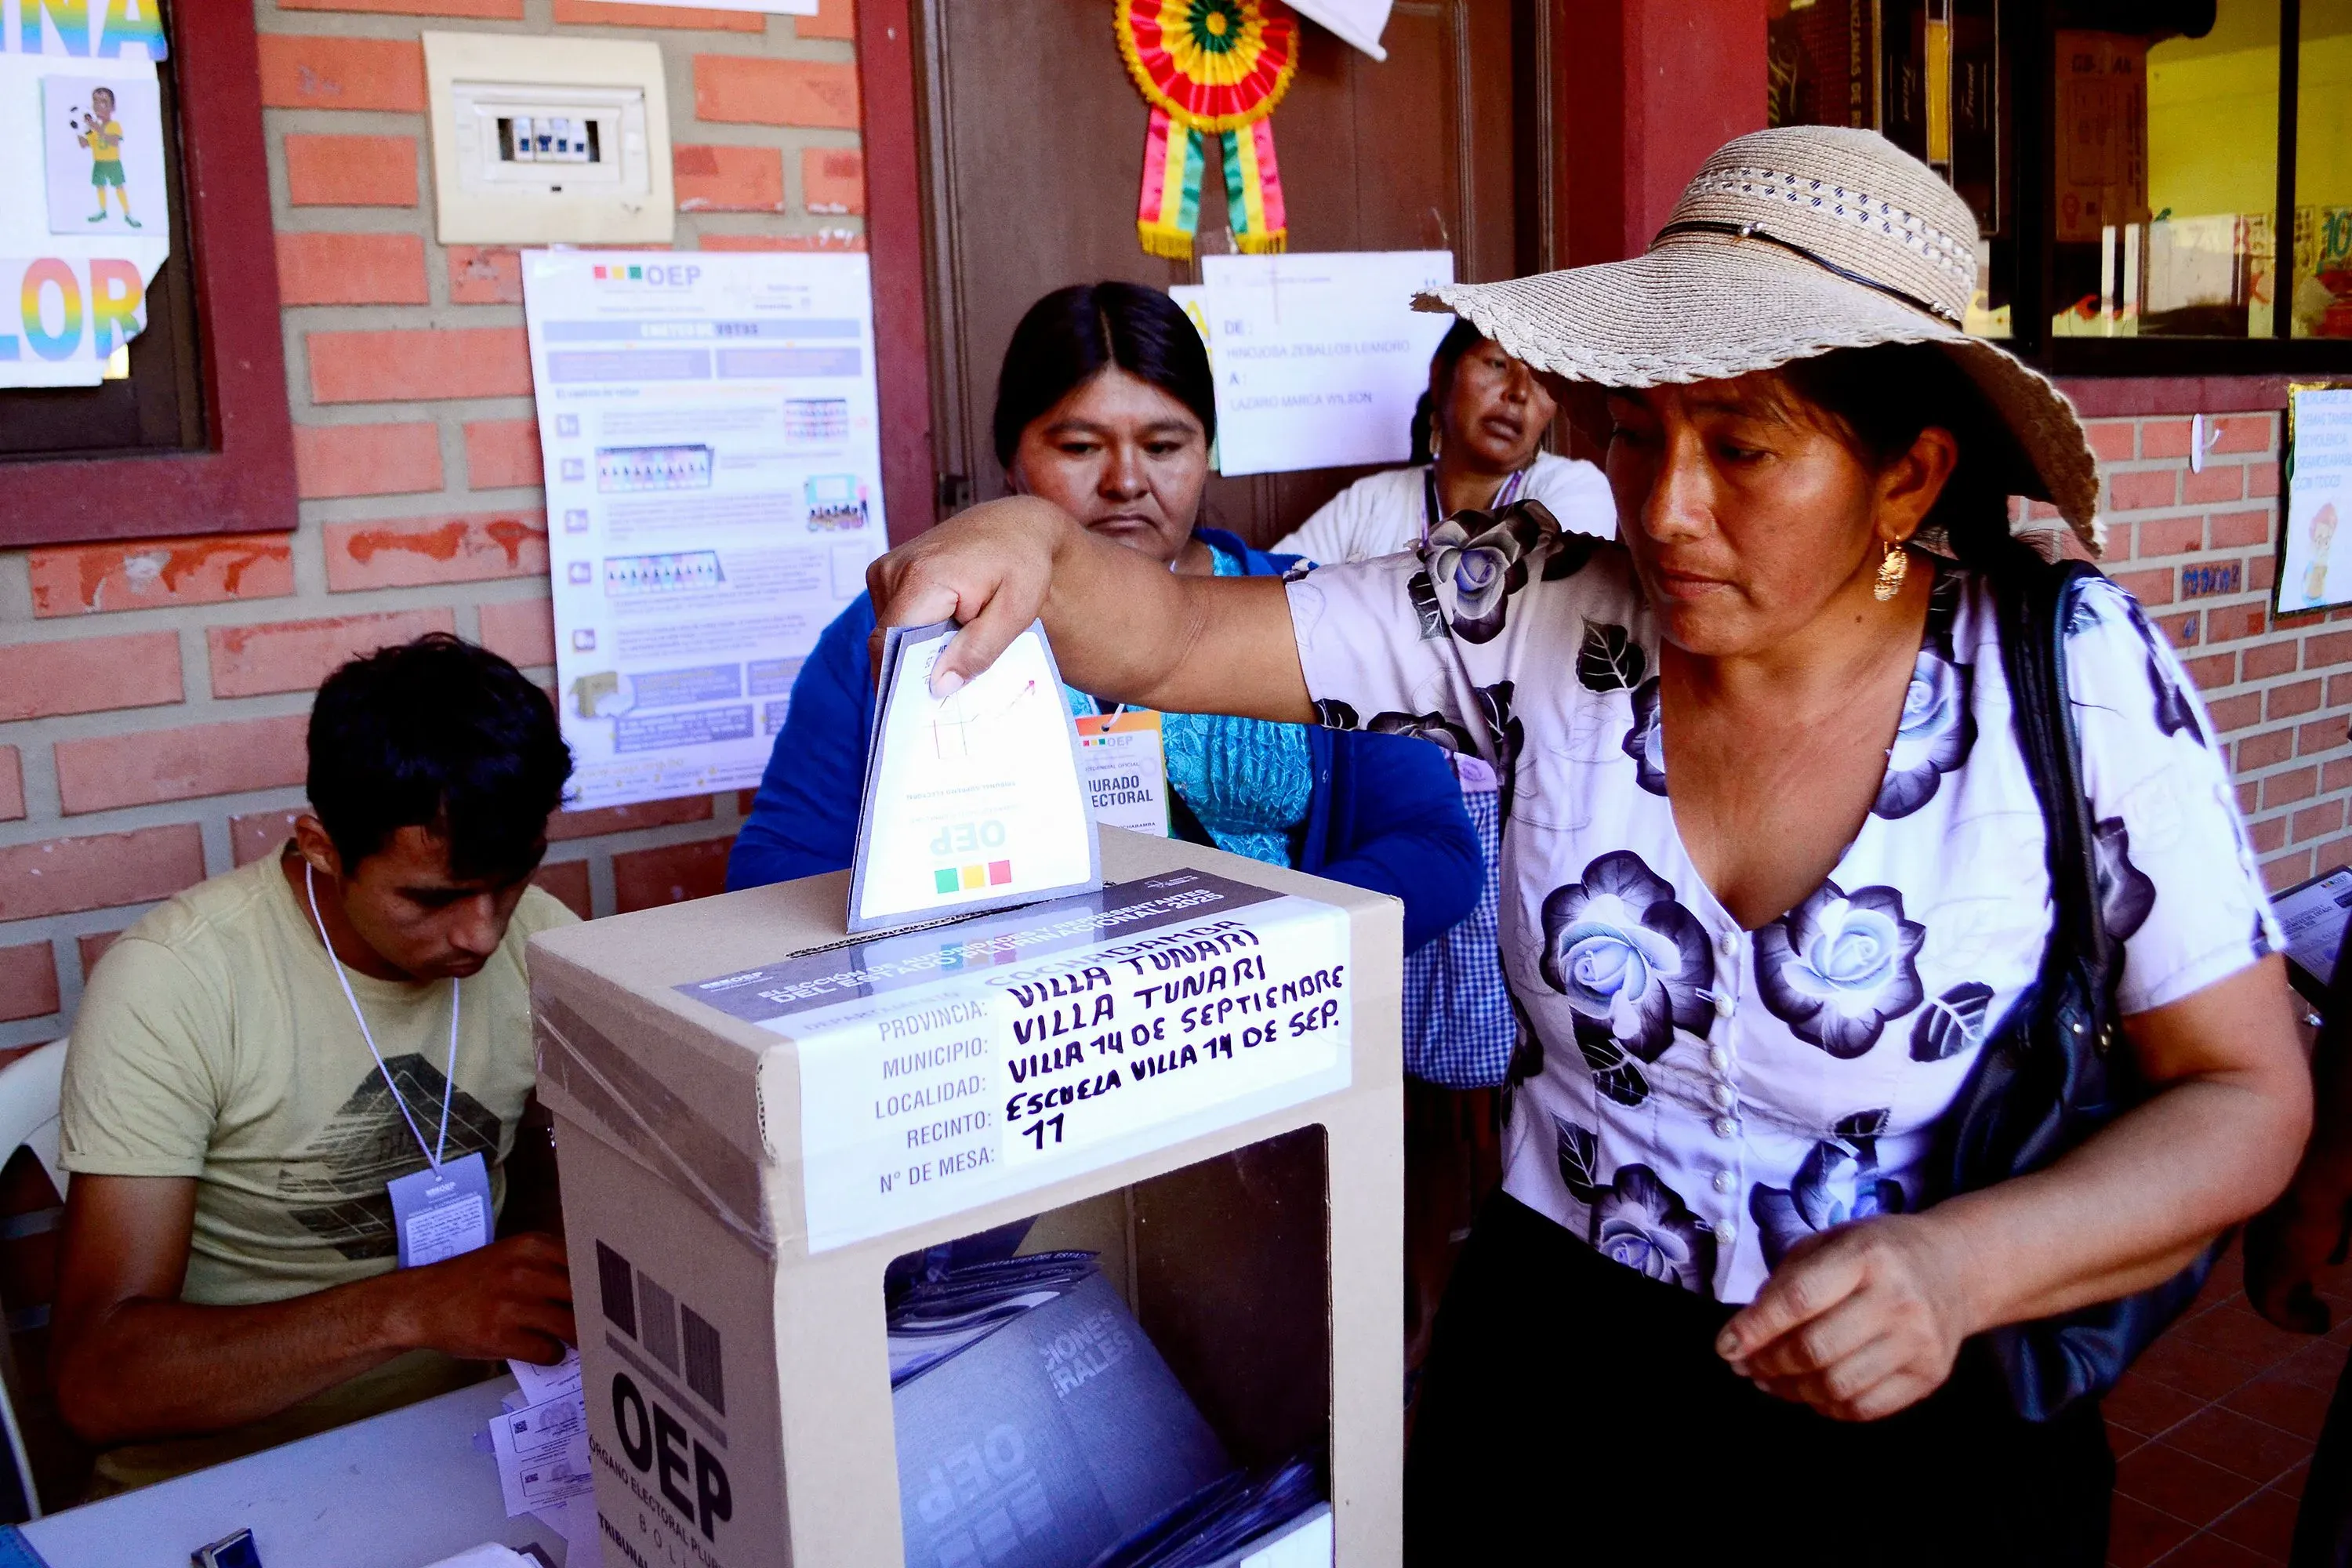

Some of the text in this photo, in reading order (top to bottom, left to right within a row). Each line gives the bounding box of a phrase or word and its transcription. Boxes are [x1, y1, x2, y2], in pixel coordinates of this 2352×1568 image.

[0, 0, 169, 61] NA
[646, 264, 702, 286] OEP
[0, 257, 144, 361] OR
[1106, 735, 1134, 747] OEP
[1091, 789, 1153, 808] ECTORAL
[929, 819, 1006, 856] OEP
[757, 967, 868, 999] ELECCIÓN
[902, 931, 1038, 965] AUTORIDADES
[1052, 887, 1211, 931] REPRESENTANTES
[770, 892, 1225, 1004] DEL ESTADO PLURINACIONAL 2025
[985, 920, 1246, 988] COCHABAMBA
[1007, 929, 1260, 1010] VILLA TUNARI
[879, 1000, 988, 1042] PROVINCIA:
[1013, 954, 1266, 1045] VILLA TUNARI
[883, 1036, 989, 1080] MUNICIPIO:
[1006, 1069, 1122, 1121] ESCUELA
[1131, 1044, 1198, 1081] VILLA
[1243, 1019, 1277, 1048] DE
[1288, 999, 1339, 1037] SEP.
[1008, 1040, 1083, 1083] VILLA
[1090, 1030, 1123, 1055] 14
[1131, 1017, 1165, 1047] DE
[876, 1075, 986, 1120] LOCALIDAD:
[907, 1110, 992, 1149] RECINTO:
[1022, 1112, 1065, 1150] 11
[909, 1162, 932, 1185] DE
[939, 1146, 995, 1178] MESA:
[612, 1372, 733, 1544] OEP
[630, 1476, 689, 1546] ELECTORAL
